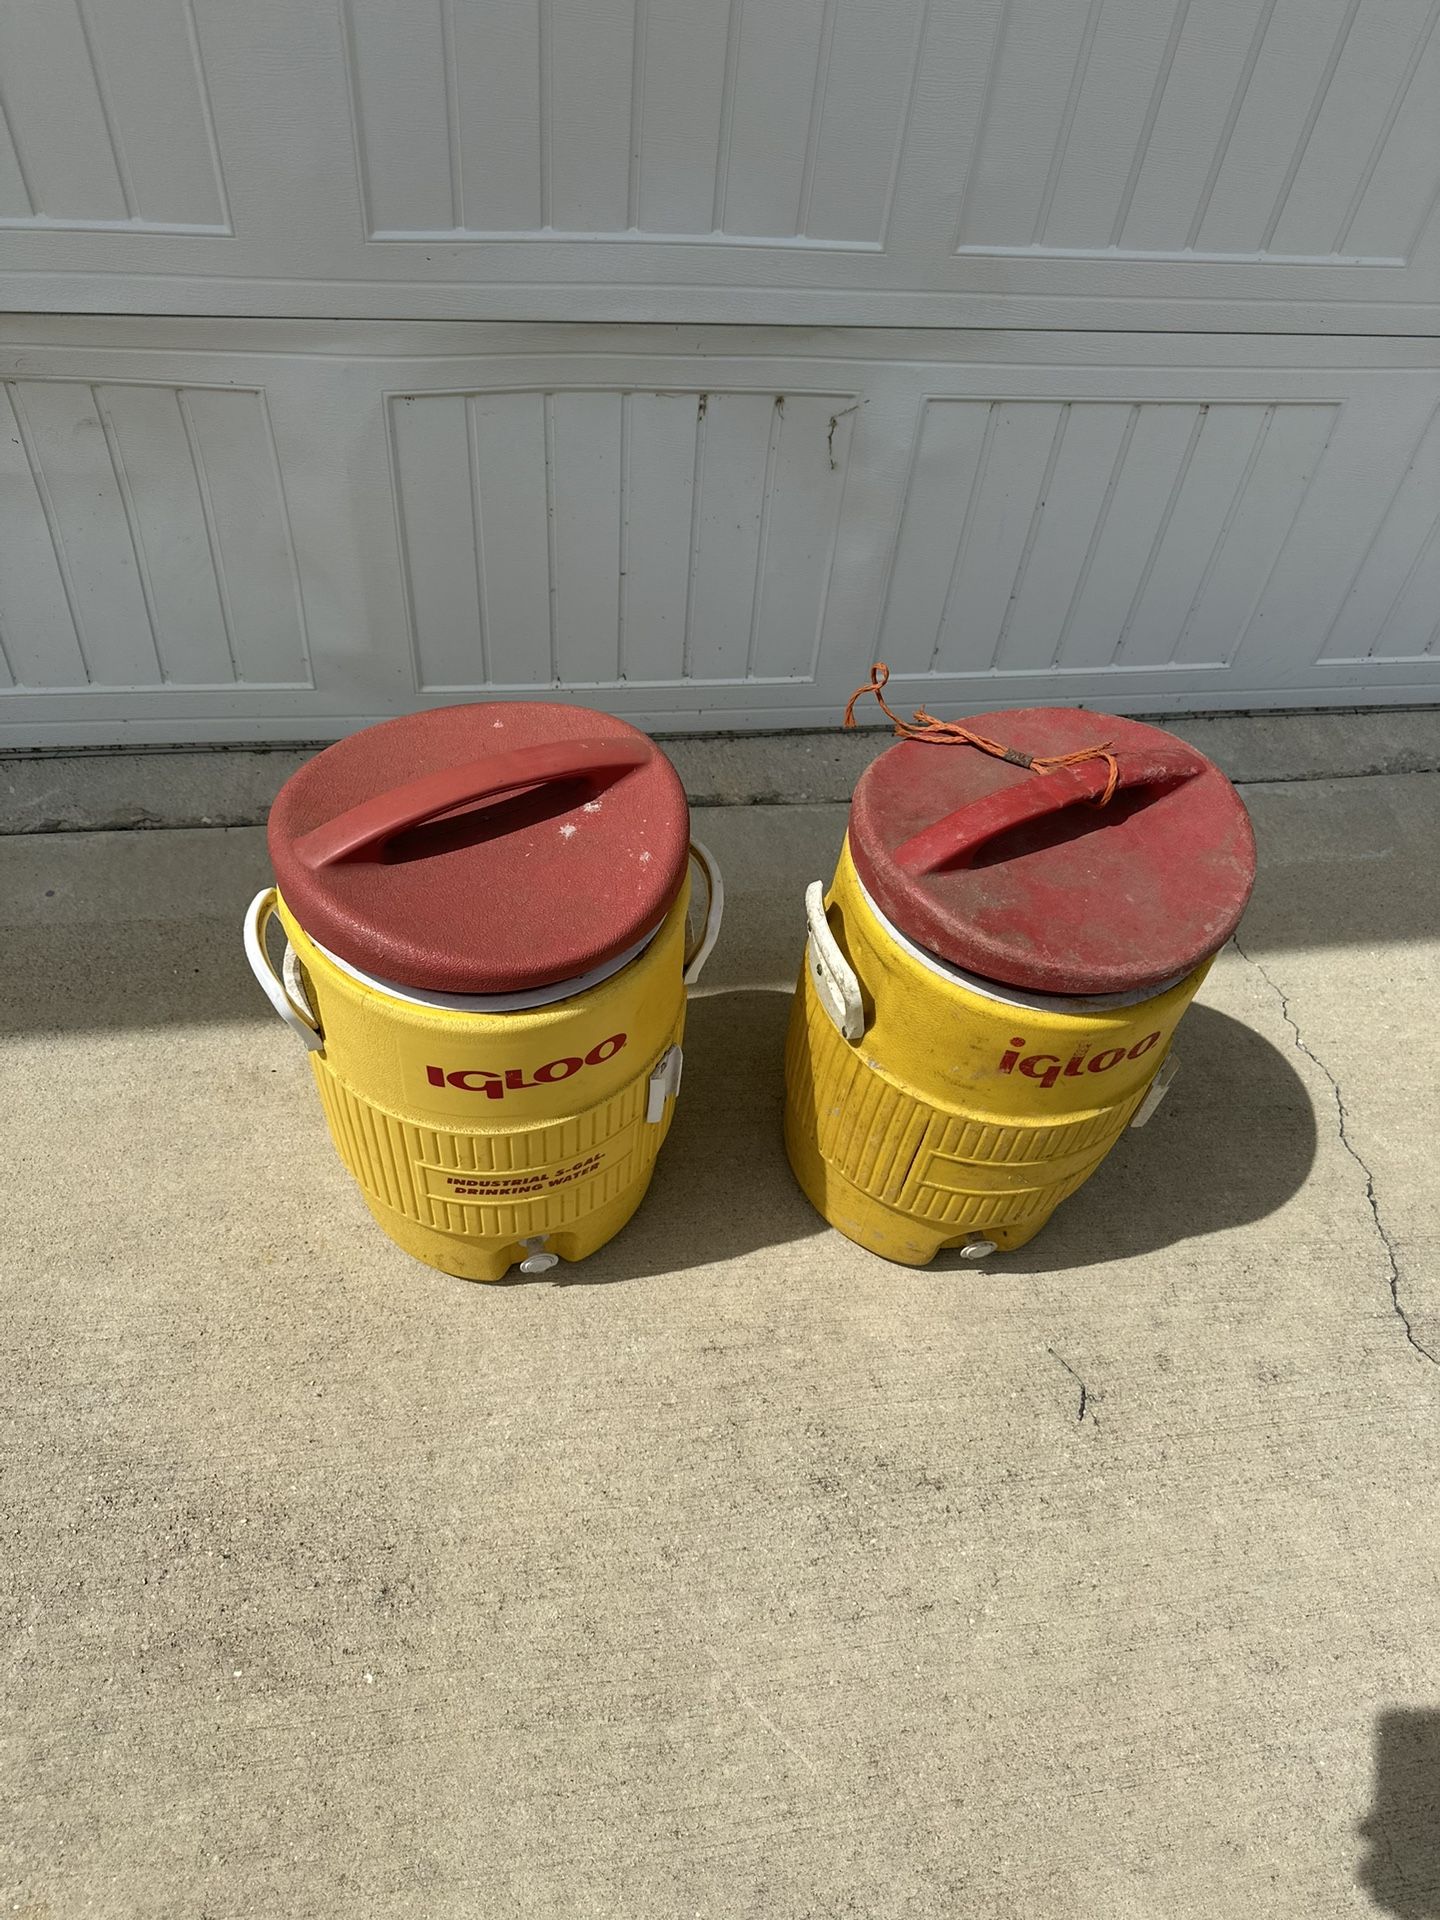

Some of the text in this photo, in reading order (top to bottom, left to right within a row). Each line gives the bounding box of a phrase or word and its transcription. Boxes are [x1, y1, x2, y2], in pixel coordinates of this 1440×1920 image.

[426, 1032, 628, 1099] IGLOO
[446, 1173, 549, 1188] INDUSTRIAL
[454, 1162, 601, 1196] DRINKING WATER
